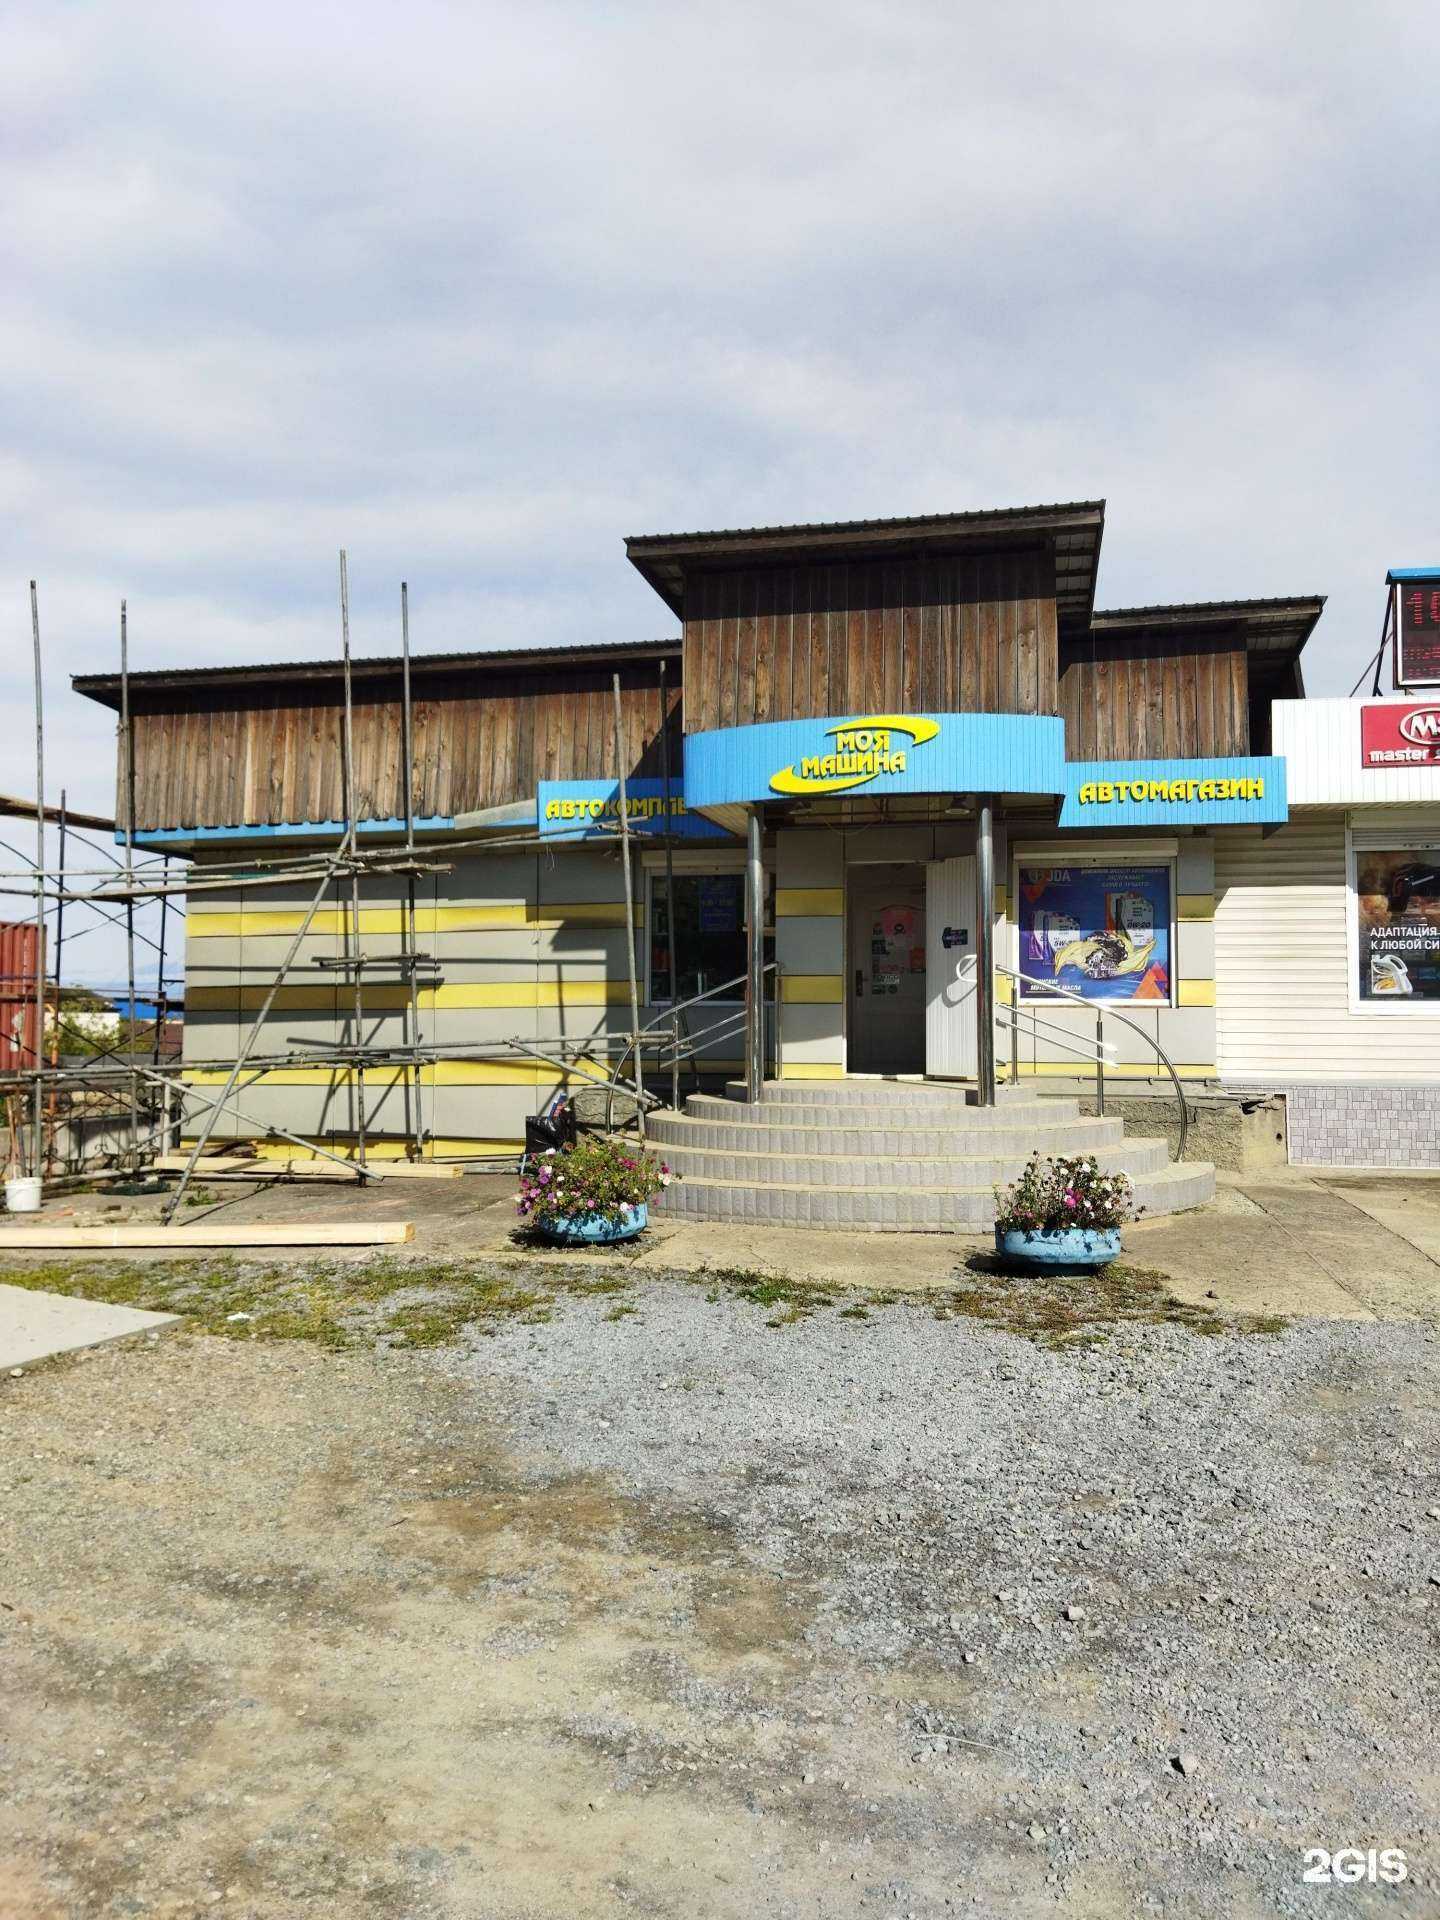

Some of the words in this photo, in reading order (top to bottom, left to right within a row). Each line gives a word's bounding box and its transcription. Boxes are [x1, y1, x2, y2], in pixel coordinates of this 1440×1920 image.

[836, 729, 891, 753] МОЯ
[801, 751, 906, 779] МАШИНА
[1369, 747, 1430, 763] master
[1079, 777, 1264, 804] АВТОМАГАЗИН
[1370, 926, 1437, 938] АДАПТАЦИЯ
[1371, 940, 1378, 949] К
[1380, 938, 1421, 949] ЛЮБОЙ
